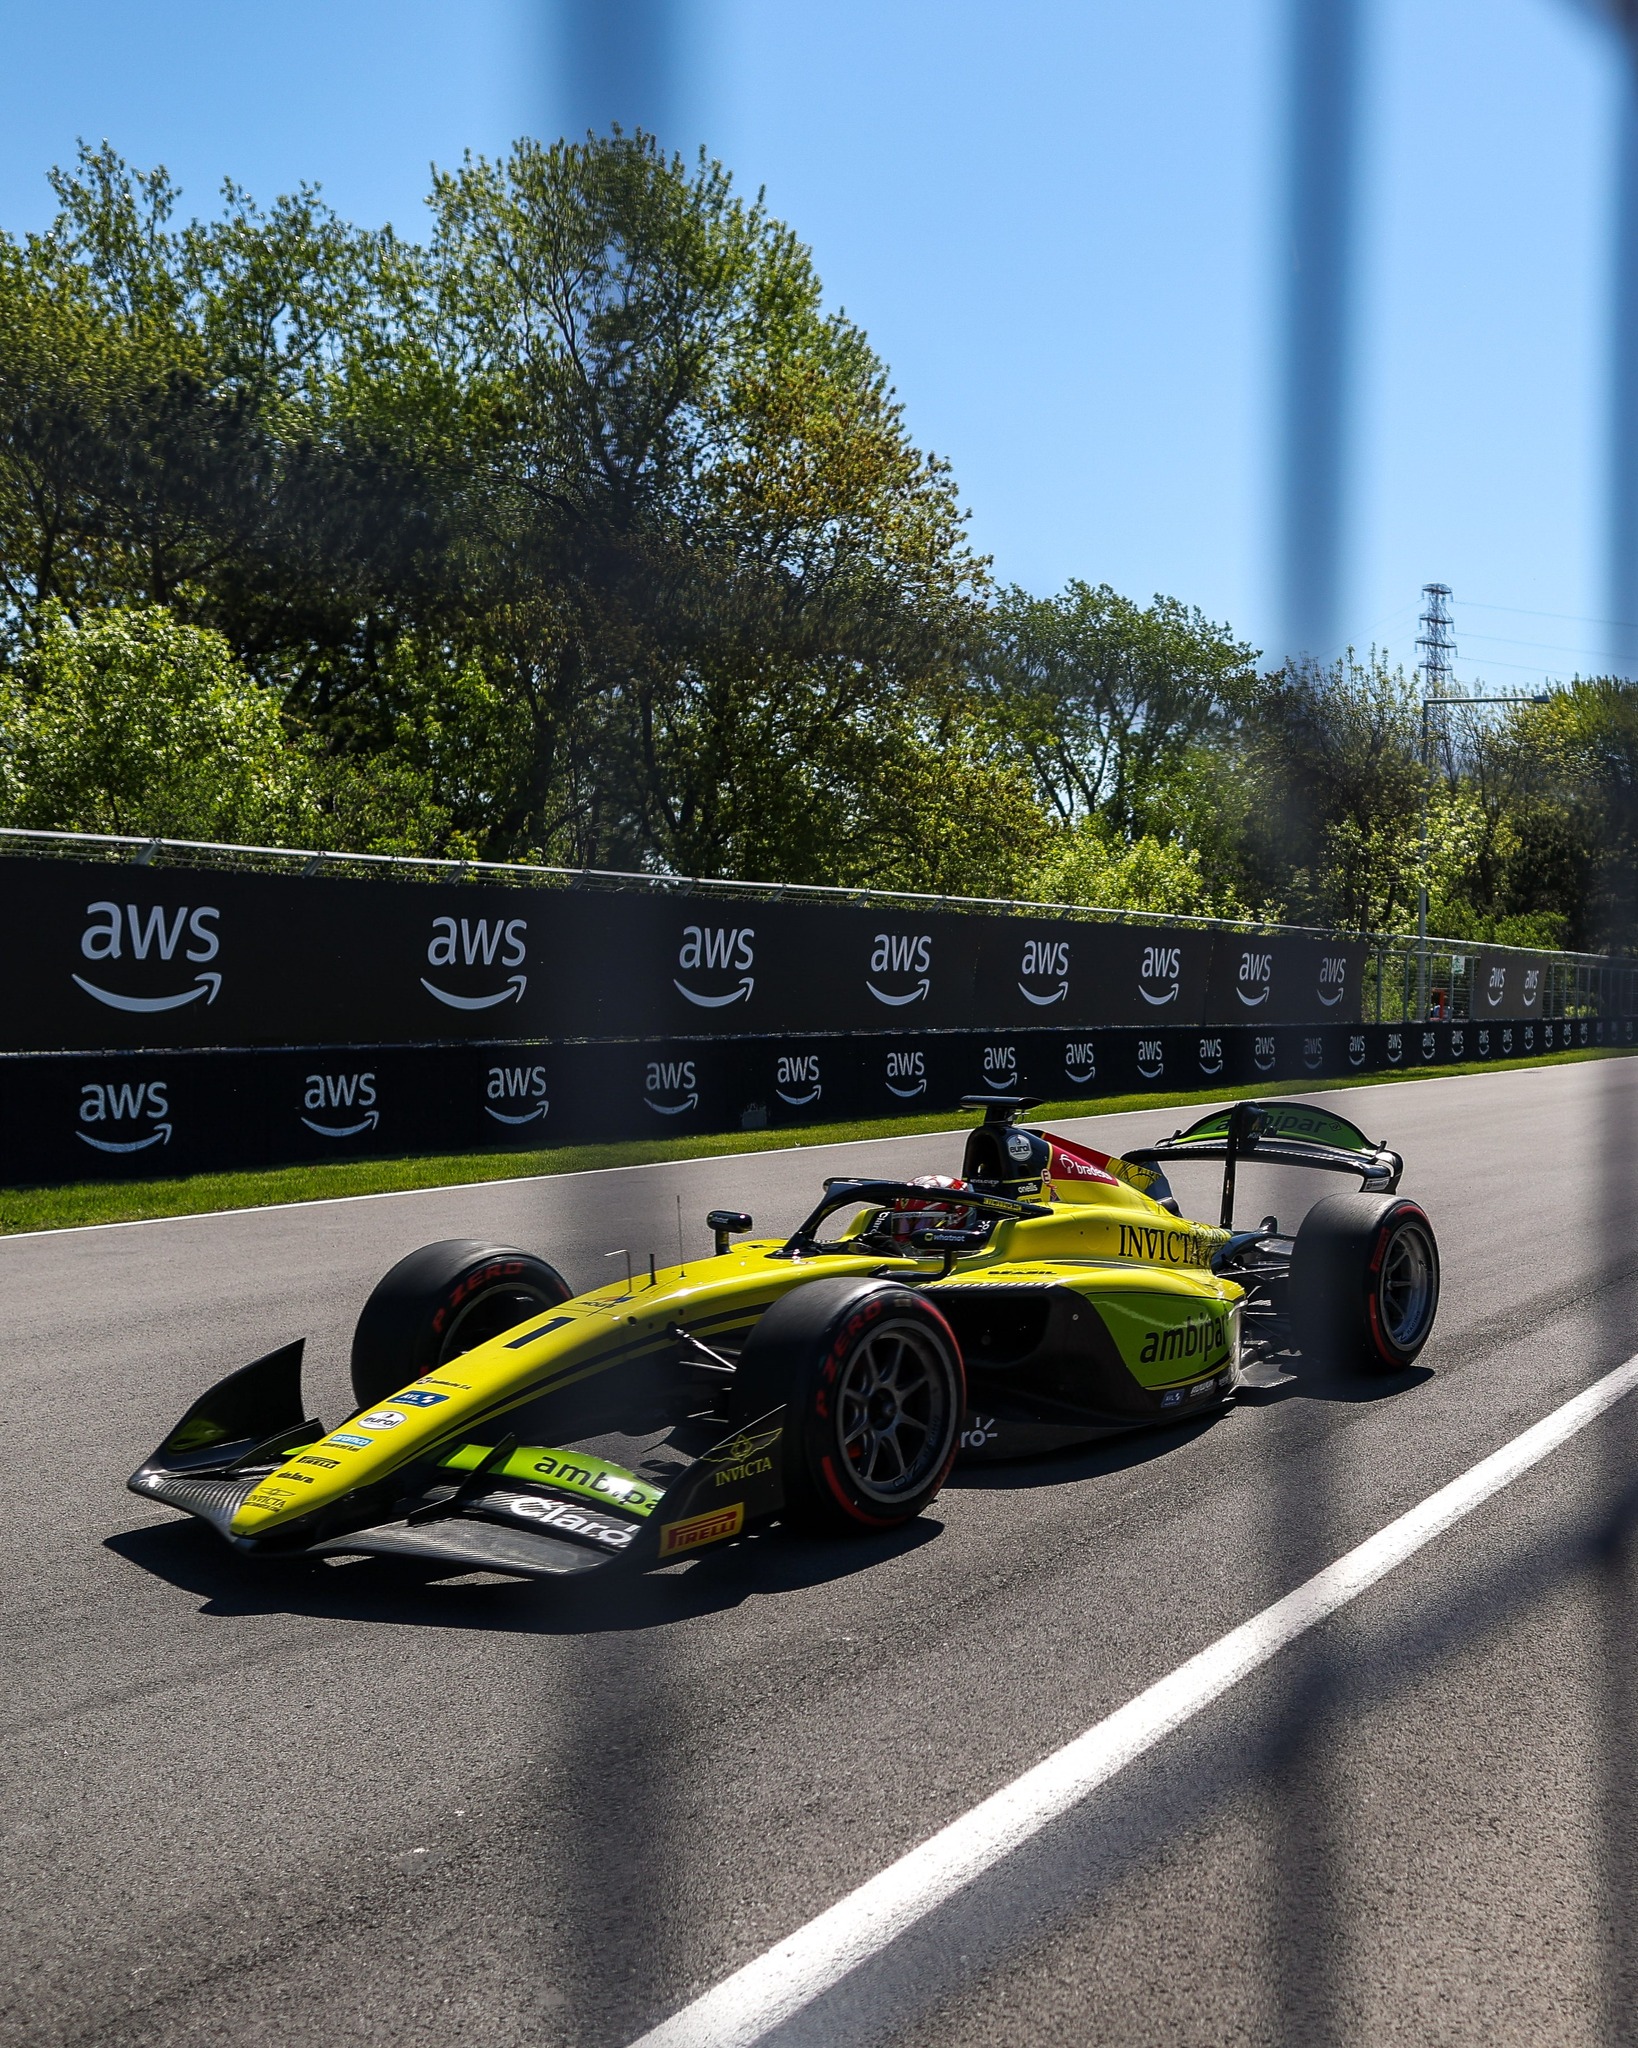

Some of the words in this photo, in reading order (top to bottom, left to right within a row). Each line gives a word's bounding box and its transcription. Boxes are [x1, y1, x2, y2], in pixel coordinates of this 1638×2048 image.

[82, 902, 219, 962] aws
[428, 917, 527, 966] aws
[680, 926, 754, 970] aws
[871, 934, 931, 972] aws
[1022, 941, 1069, 975] aws
[1142, 947, 1180, 978] aws
[1240, 953, 1272, 981] aws
[1320, 958, 1346, 983] aws
[1490, 967, 1506, 988] aws
[1525, 970, 1540, 989] aws
[1066, 1043, 1093, 1064] aws
[1138, 1041, 1163, 1060] aws
[1200, 1039, 1222, 1058] aws
[1255, 1037, 1276, 1055] aws
[1304, 1037, 1323, 1054] aws
[1350, 1036, 1366, 1052] aws
[1388, 1034, 1403, 1049] aws
[778, 1056, 821, 1083] aws
[887, 1052, 924, 1076] aws
[984, 1047, 1015, 1069] aws
[488, 1066, 546, 1098] aws
[646, 1061, 696, 1090] aws
[80, 1082, 168, 1120] aws
[305, 1073, 376, 1109] aws
[1215, 1112, 1327, 1133] aipar
[933, 1233, 966, 1242] whatnot
[1118, 1224, 1201, 1265] INVICTA
[502, 1316, 577, 1350] 1
[1140, 1315, 1228, 1364] ambipar
[400, 1393, 421, 1401] AVL
[363, 1416, 400, 1427] eurol
[331, 1434, 370, 1446] aramco
[296, 1456, 341, 1469] PIRELLI
[716, 1457, 773, 1487] INVICTA
[510, 1496, 635, 1545] Claro
[667, 1511, 738, 1550] PIRELLI
